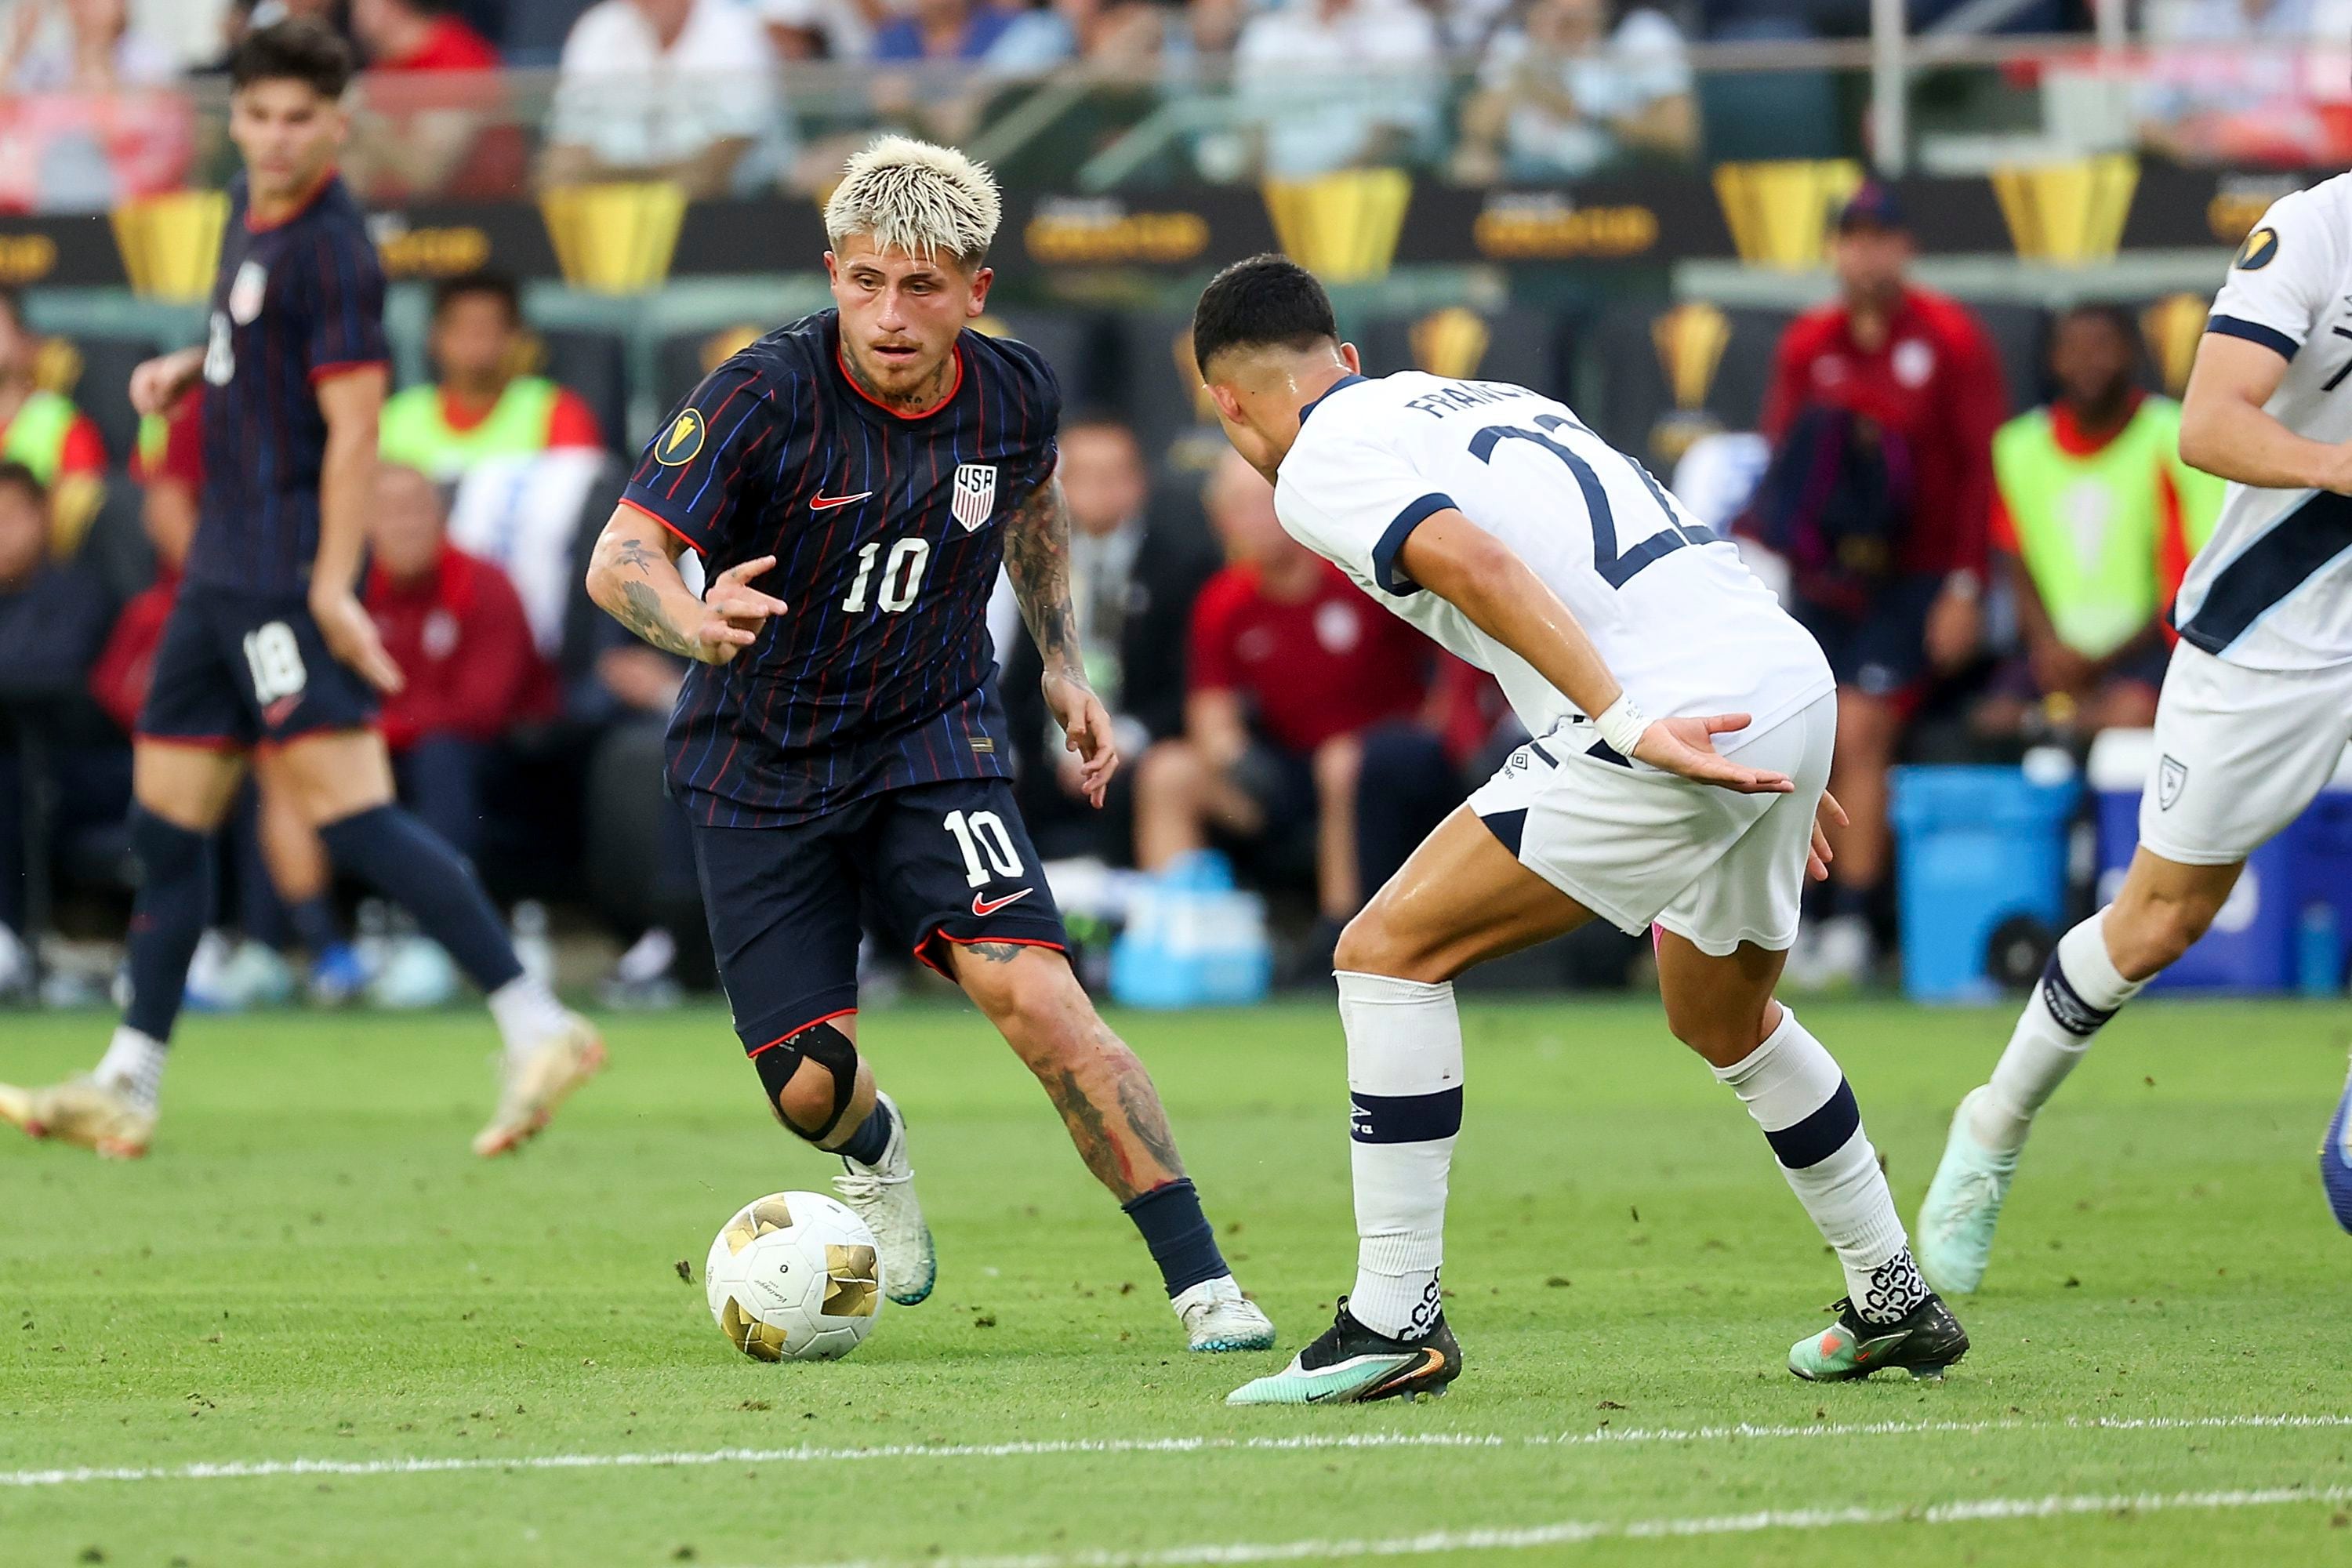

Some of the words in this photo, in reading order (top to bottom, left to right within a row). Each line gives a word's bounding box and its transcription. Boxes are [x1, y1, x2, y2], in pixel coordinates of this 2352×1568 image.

[1404, 382, 1534, 419] FRANC
[958, 467, 993, 493] USA
[1468, 414, 1719, 590] 22
[842, 537, 931, 613] 10
[243, 621, 307, 706] 18
[943, 809, 1025, 888] 10
